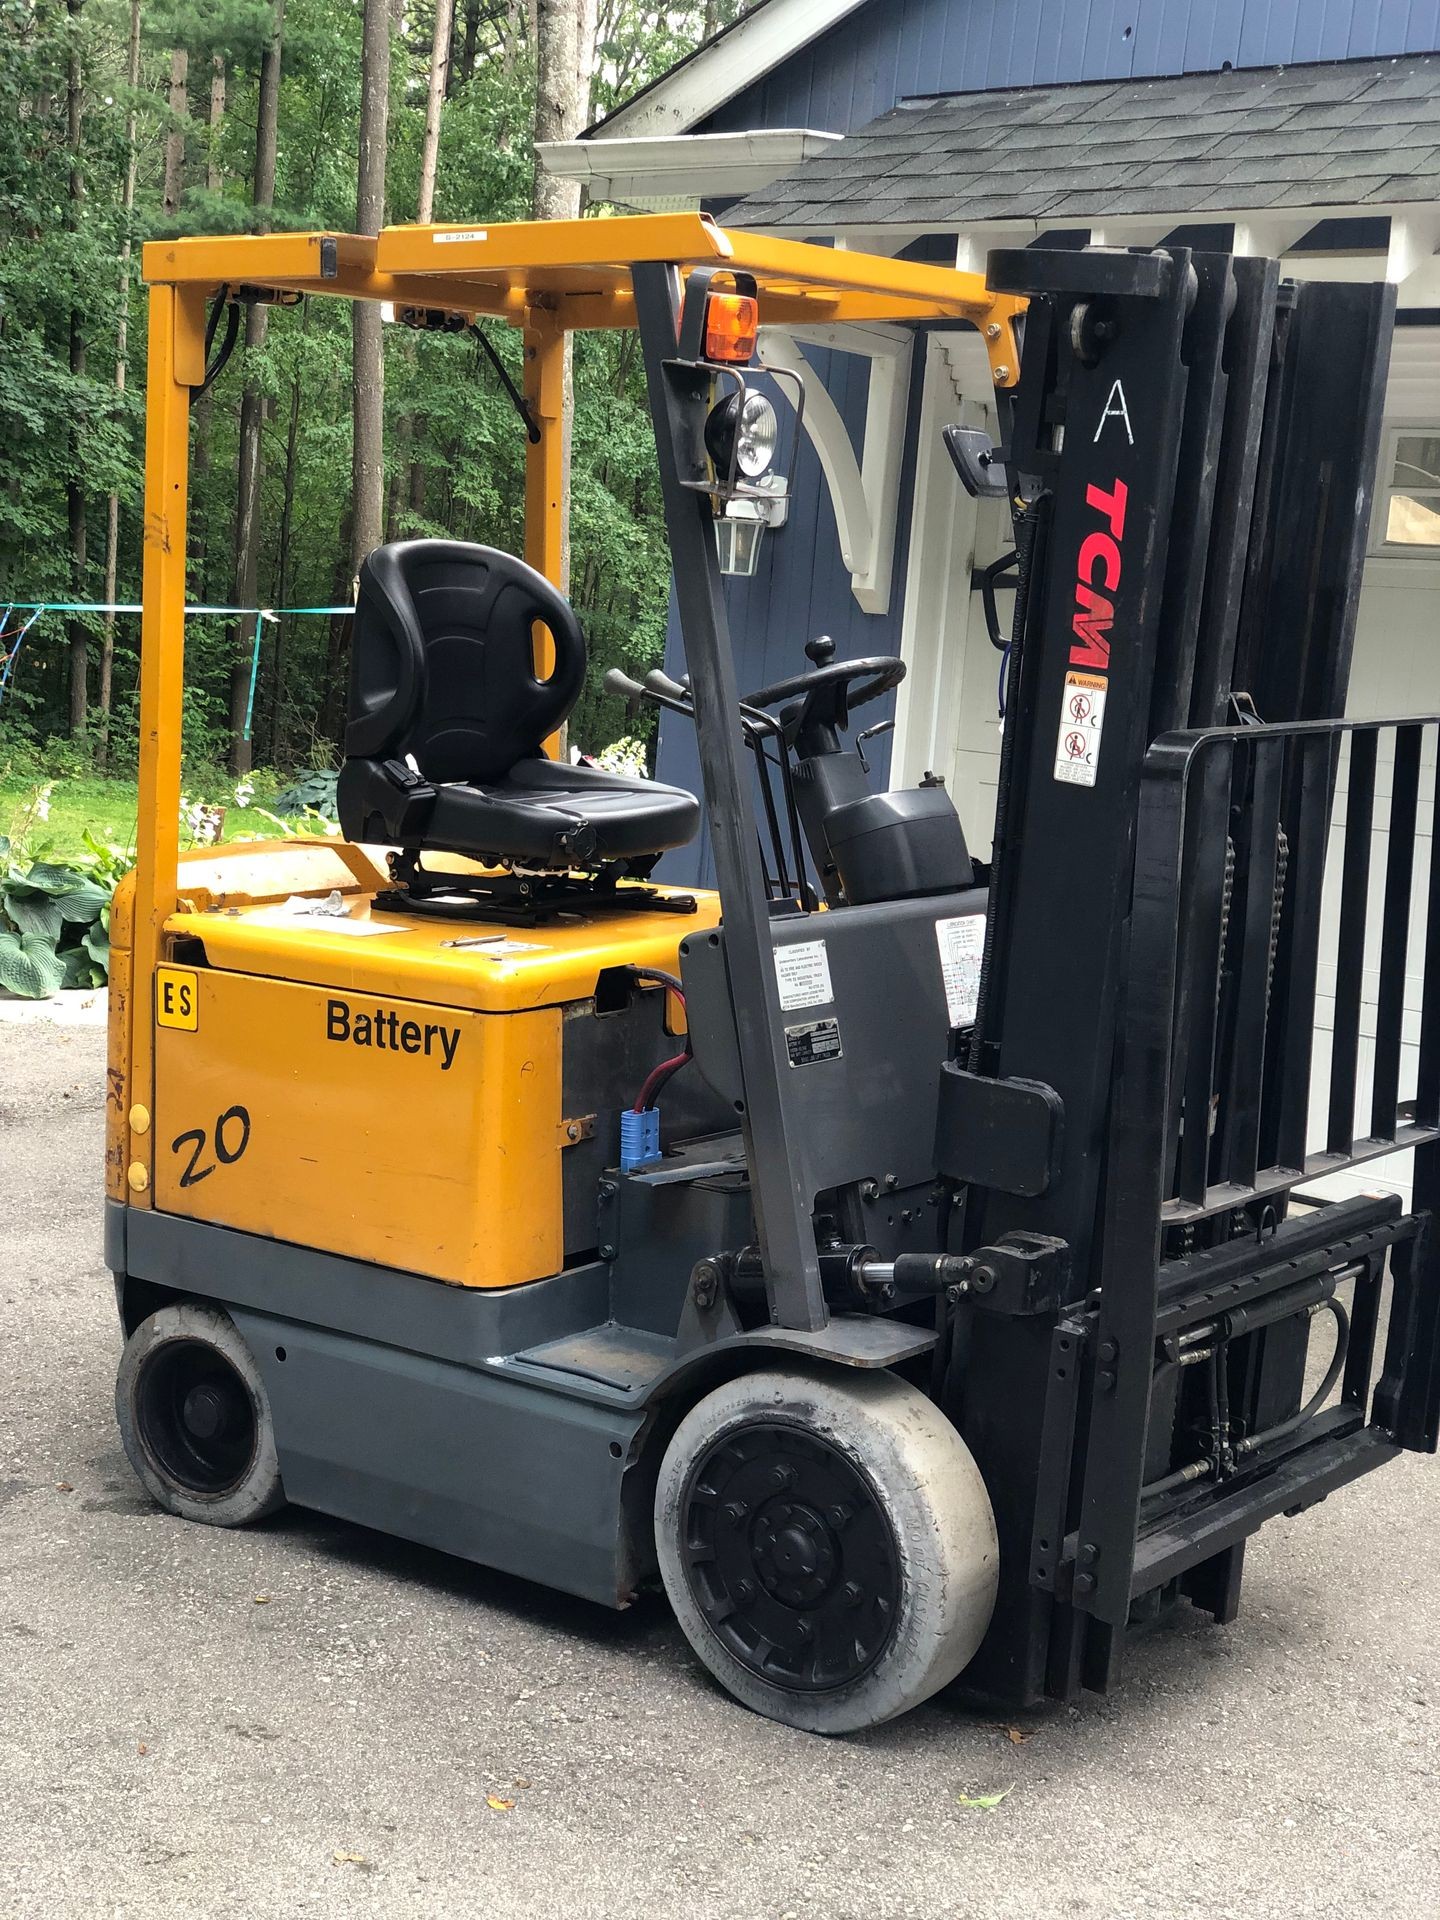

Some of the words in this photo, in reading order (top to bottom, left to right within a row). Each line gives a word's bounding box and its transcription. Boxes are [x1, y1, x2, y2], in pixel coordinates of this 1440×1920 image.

[1093, 379, 1135, 445] A
[1069, 478, 1129, 669] TCM
[1077, 677, 1106, 690] WARNING
[327, 999, 461, 1071] Battery
[171, 1105, 252, 1188] 20
